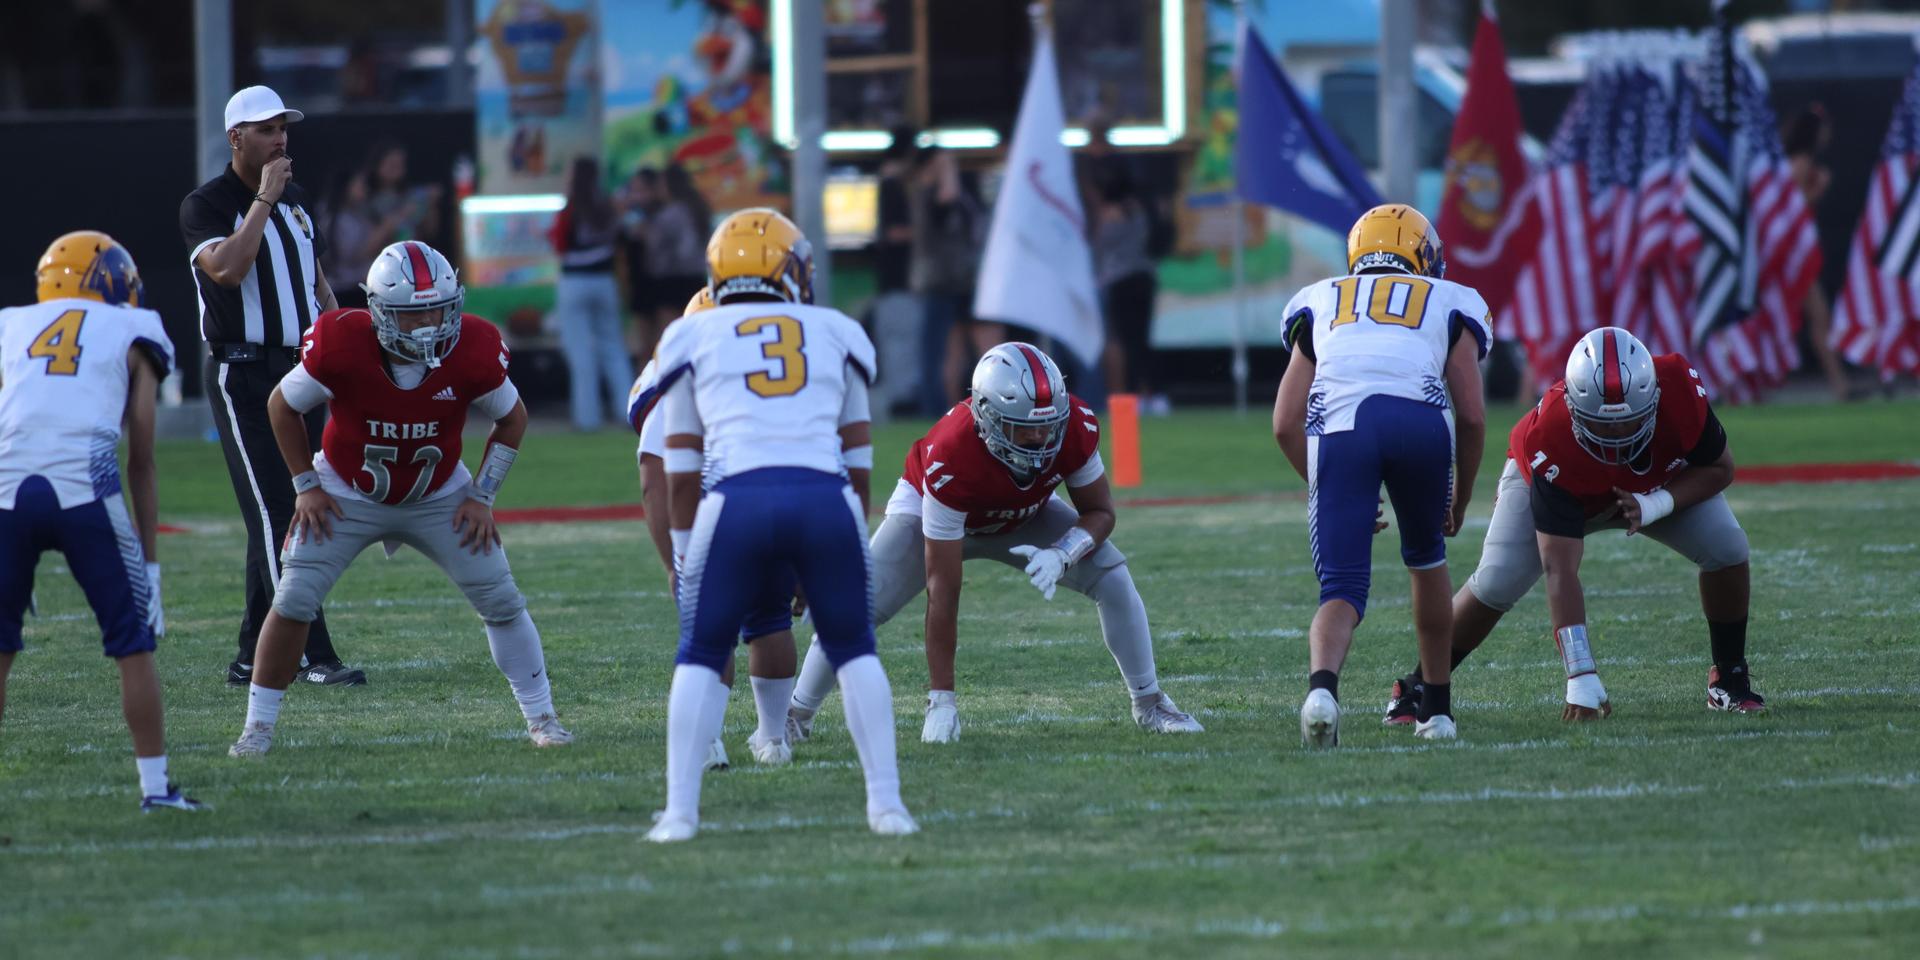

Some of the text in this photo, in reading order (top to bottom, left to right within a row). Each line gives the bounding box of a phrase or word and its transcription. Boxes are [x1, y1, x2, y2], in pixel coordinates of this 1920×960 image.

[1329, 276, 1434, 331] 10
[27, 309, 87, 376] 4
[735, 315, 807, 399] 3
[366, 419, 439, 440] TRIBE
[352, 444, 443, 505] 52
[926, 461, 954, 491] 11
[307, 671, 326, 683] HOKA
